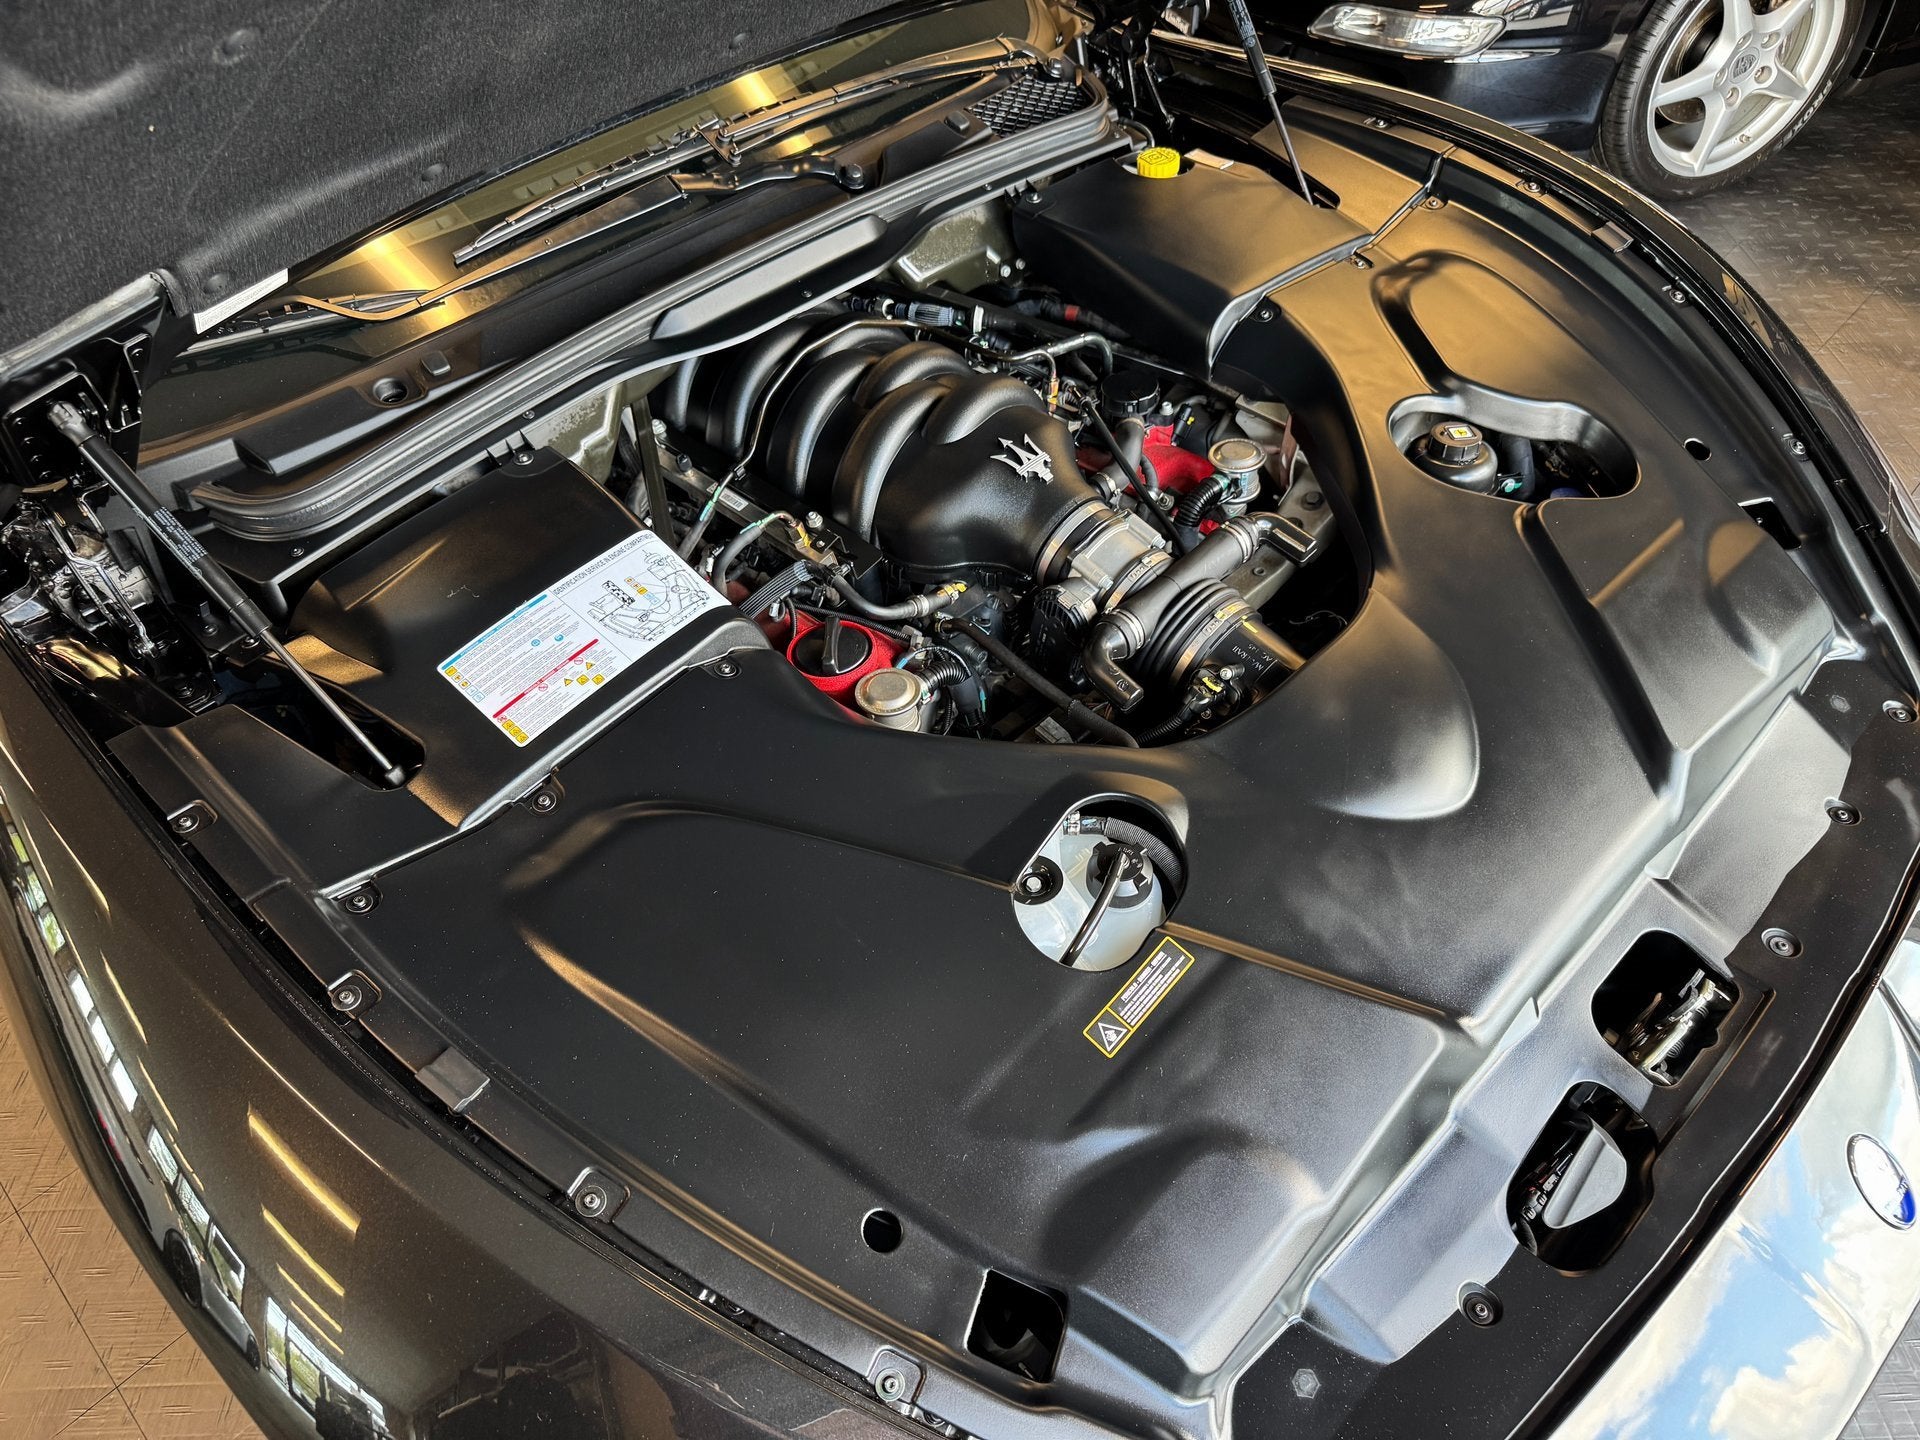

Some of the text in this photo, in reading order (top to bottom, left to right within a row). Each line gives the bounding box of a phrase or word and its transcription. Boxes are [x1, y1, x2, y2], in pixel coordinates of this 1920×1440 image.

[553, 571, 587, 595] IDENTIFICATION
[585, 559, 605, 575] SERVICE
[608, 546, 626, 560] ENGINE
[1232, 645, 1264, 671] MARATI
